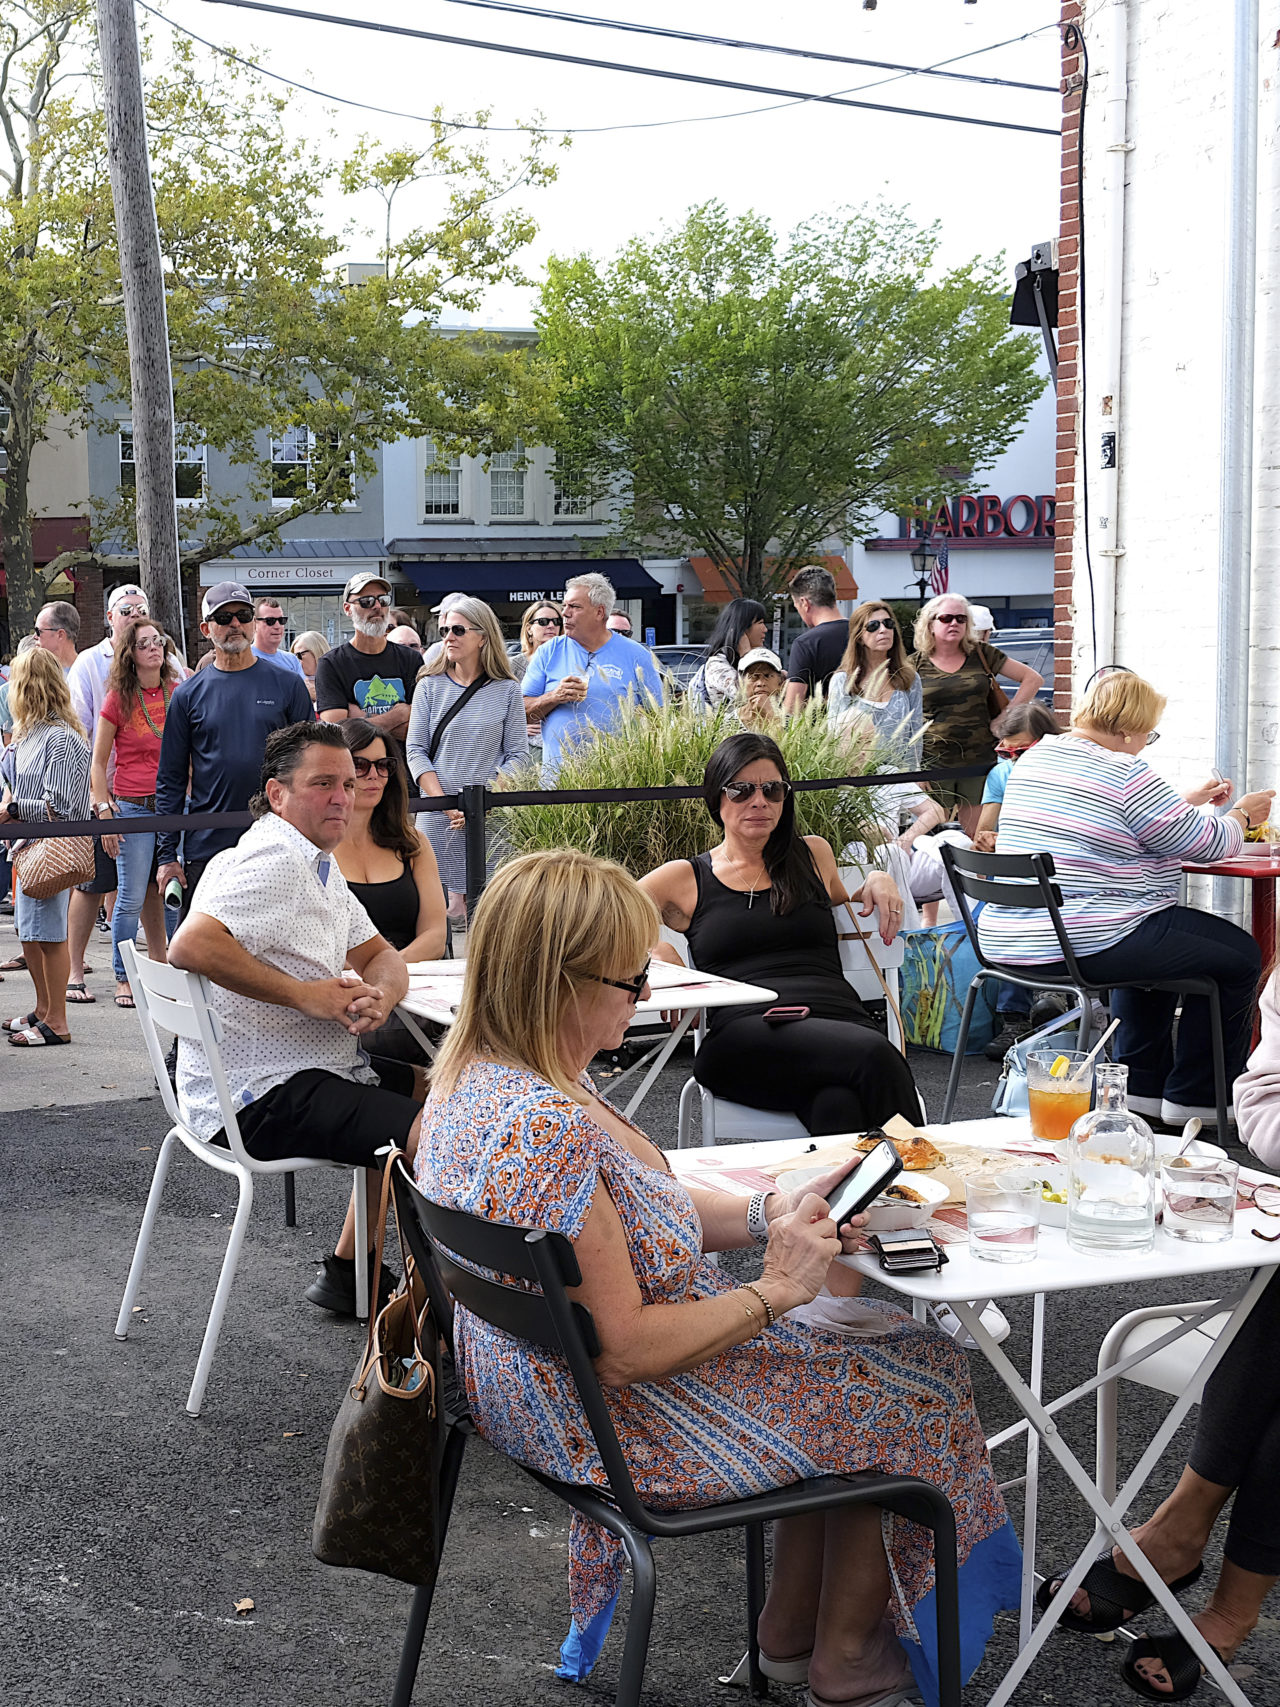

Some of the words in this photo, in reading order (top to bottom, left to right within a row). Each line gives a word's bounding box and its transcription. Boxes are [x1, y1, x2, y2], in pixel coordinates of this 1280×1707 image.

[248, 568, 291, 579] Corner
[295, 567, 334, 578] Closet
[510, 591, 546, 602] HENRY
